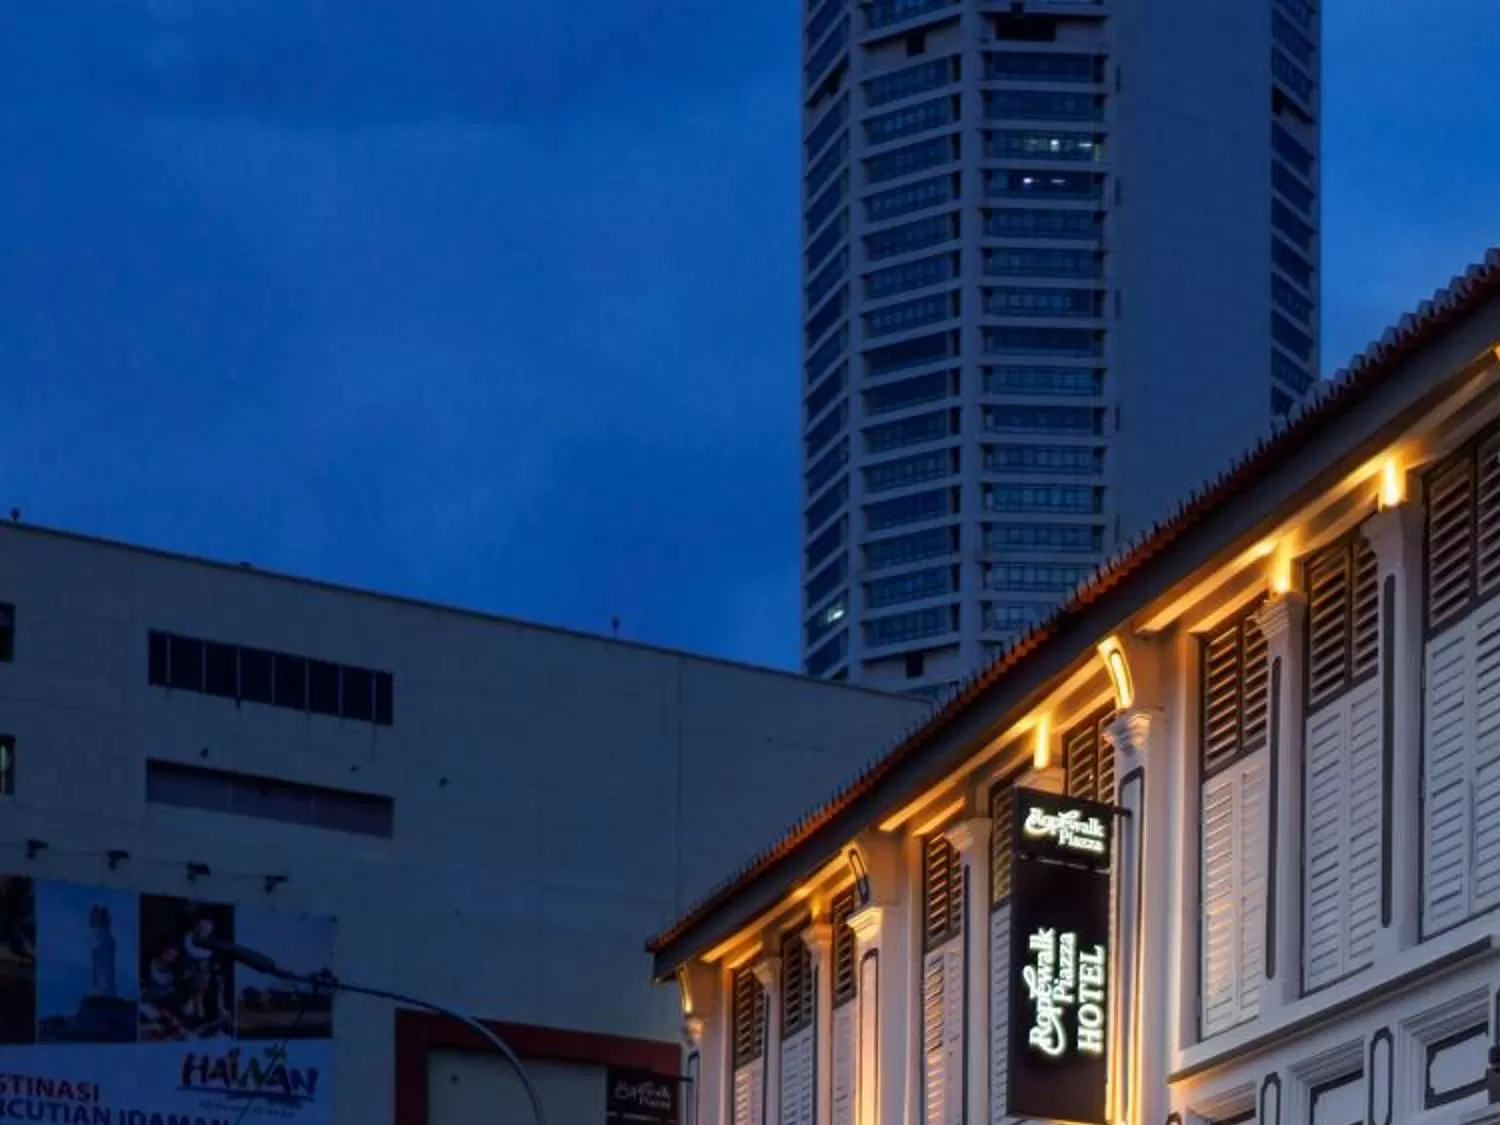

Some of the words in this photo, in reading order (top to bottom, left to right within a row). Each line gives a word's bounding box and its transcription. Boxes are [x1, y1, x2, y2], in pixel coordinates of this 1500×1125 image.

[1025, 807, 1104, 838] Ropewalk
[1058, 828, 1104, 852] Piazza
[1023, 928, 1065, 1056] Ropewalk
[1053, 933, 1077, 1003] Piazza
[1077, 945, 1105, 1054] HOTEL
